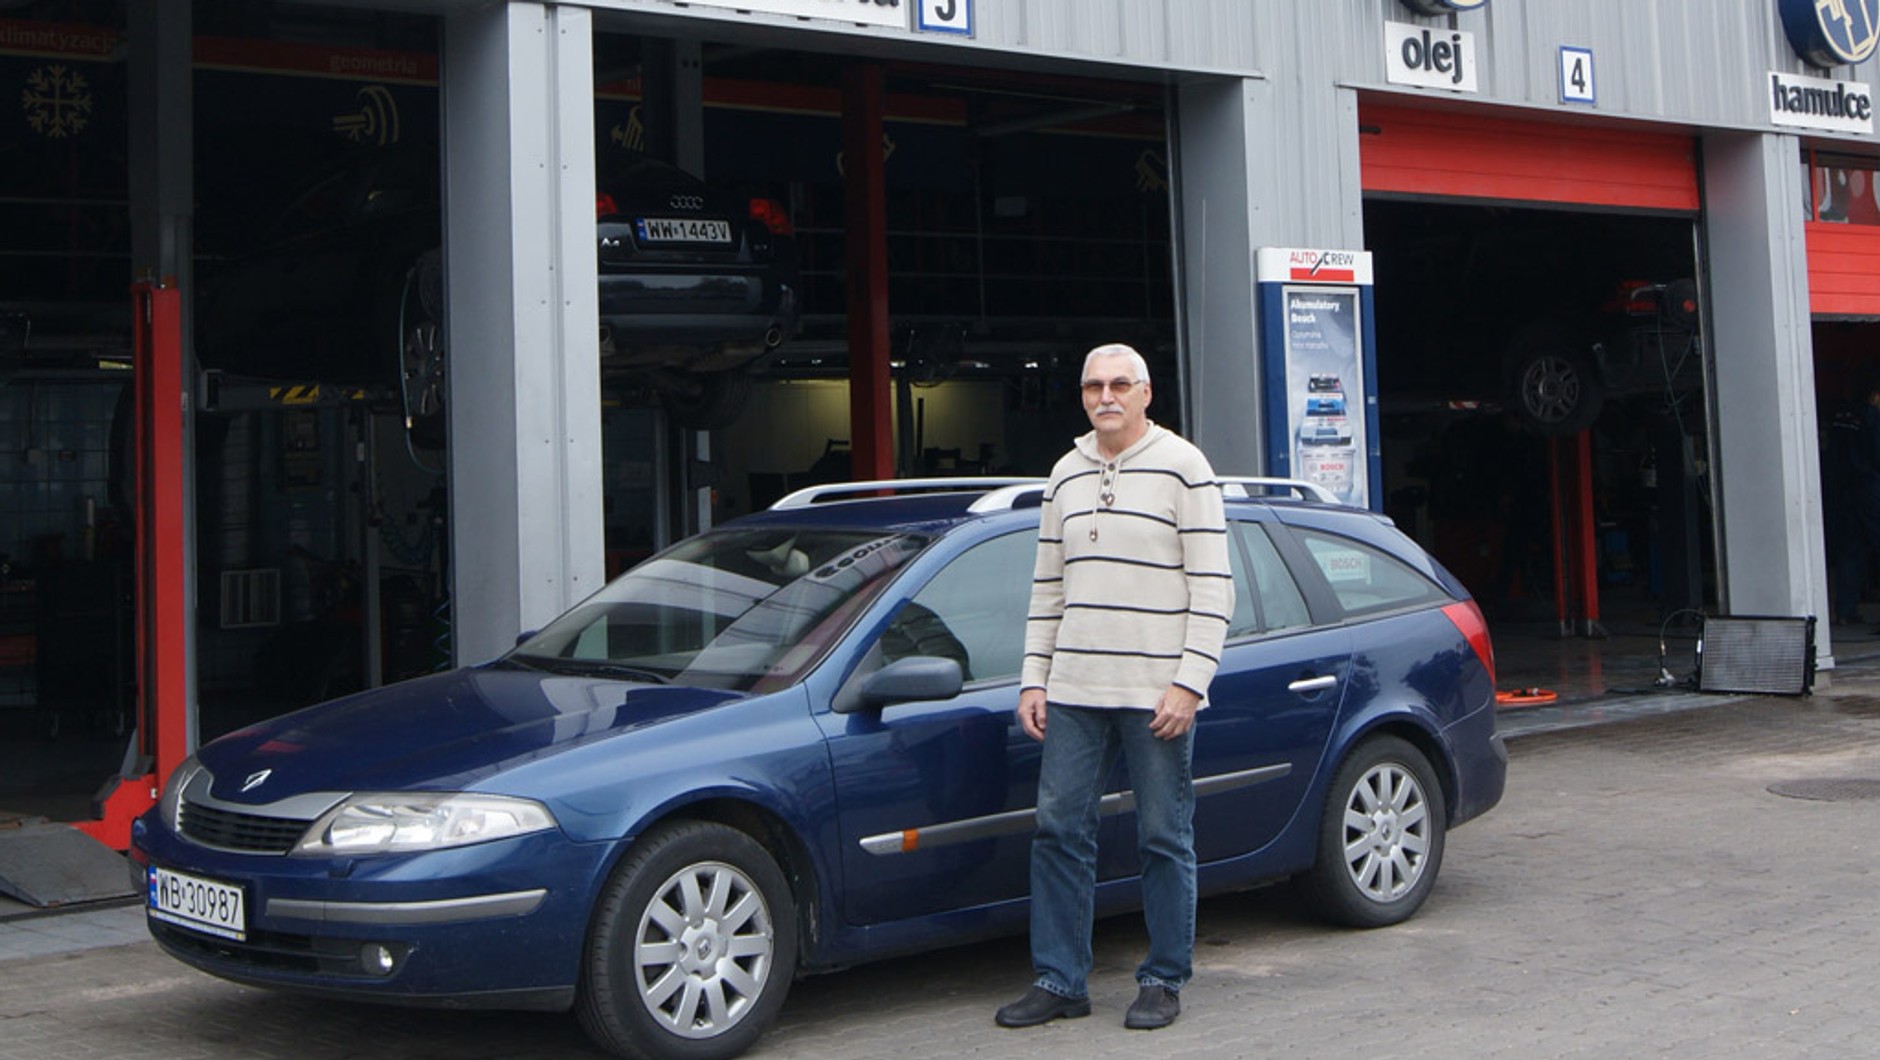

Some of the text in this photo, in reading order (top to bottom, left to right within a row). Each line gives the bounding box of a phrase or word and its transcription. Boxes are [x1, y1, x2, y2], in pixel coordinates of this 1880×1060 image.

[329, 54, 418, 76] geometria
[1401, 29, 1463, 84] olej
[1571, 57, 1586, 94] 4
[1771, 75, 1871, 120] hamulce
[1290, 251, 1355, 266] AUTO CREW
[1330, 557, 1361, 570] BOSCH
